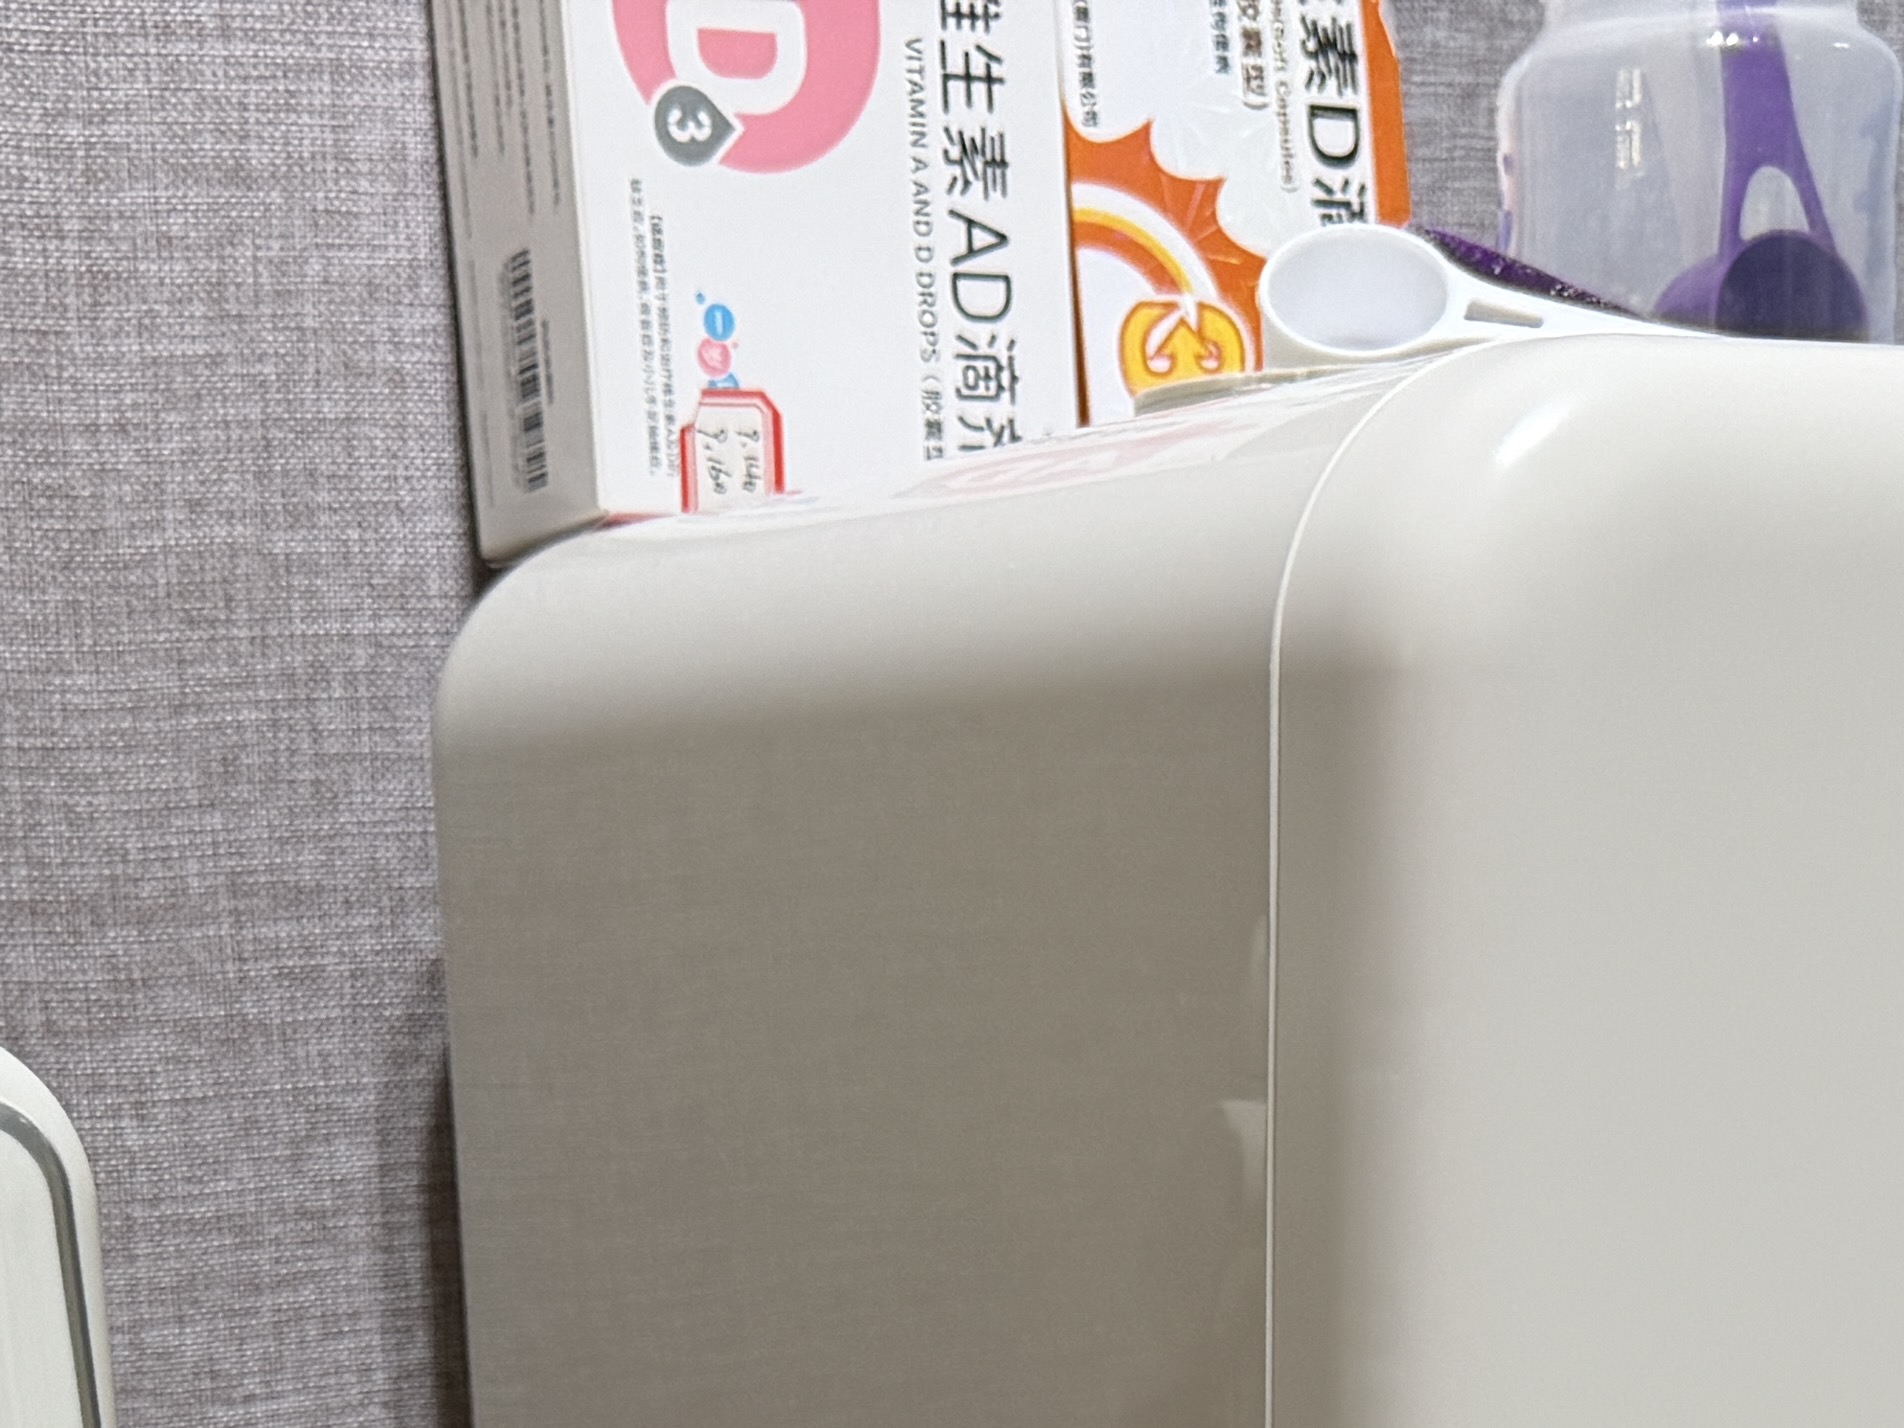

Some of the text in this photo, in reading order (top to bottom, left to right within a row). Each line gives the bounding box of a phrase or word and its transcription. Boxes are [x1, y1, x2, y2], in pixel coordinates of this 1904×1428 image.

[666, 104, 713, 144] 3
[904, 38, 940, 363] VITAMIN A AND D DROPS
[1298, 0, 1369, 227] 素D滴
